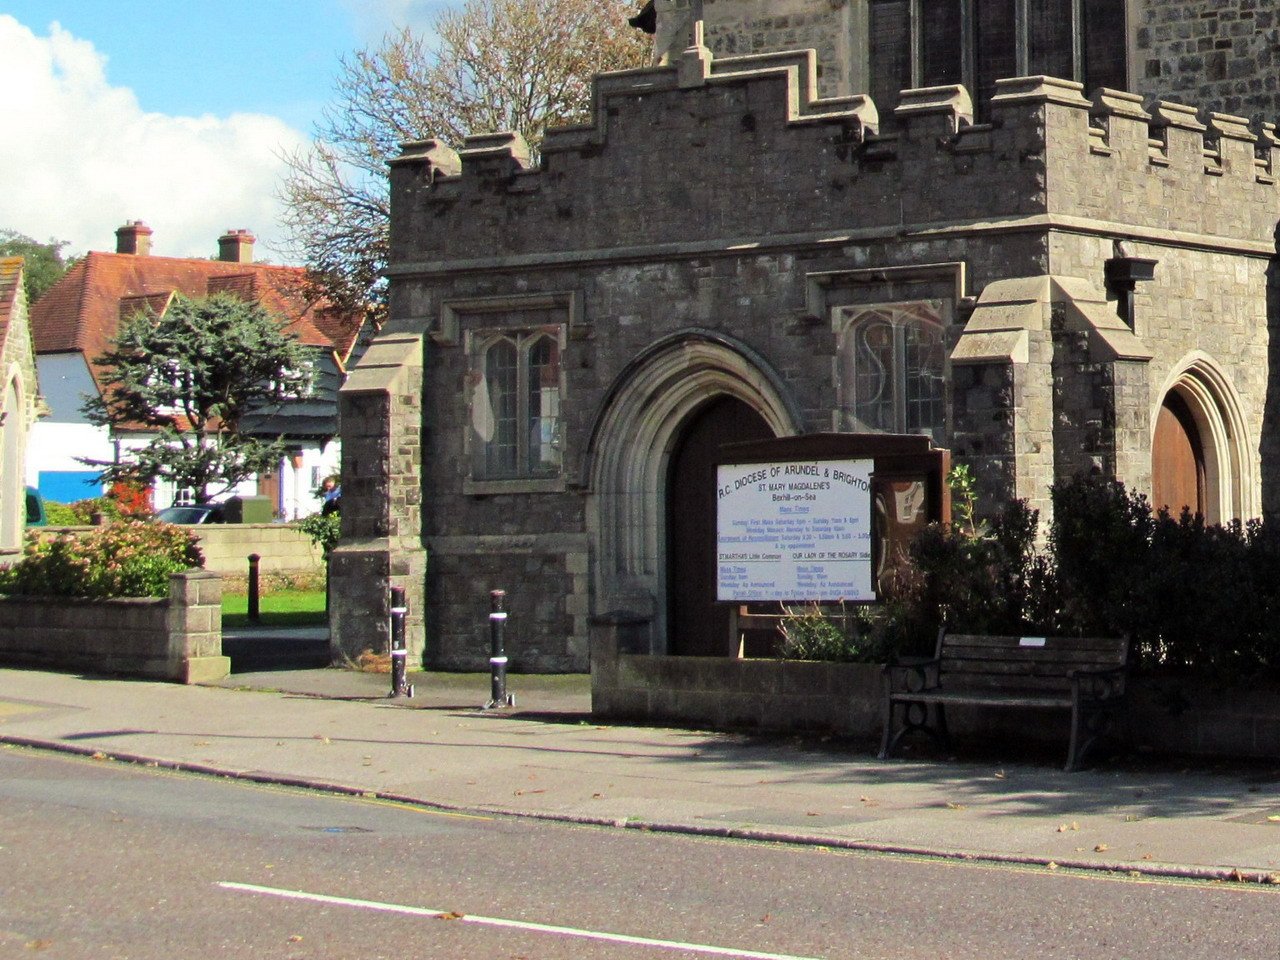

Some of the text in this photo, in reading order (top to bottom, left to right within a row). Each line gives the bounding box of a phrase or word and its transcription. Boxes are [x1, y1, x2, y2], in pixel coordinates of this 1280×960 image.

[718, 485, 732, 500] R.C.
[734, 470, 767, 490] DIOCESE
[770, 466, 780, 478] OF
[784, 465, 820, 476] ARUNDEL
[824, 468, 829, 478] &
[768, 483, 786, 491] MARY
[788, 482, 830, 490] MAGDALENE'S
